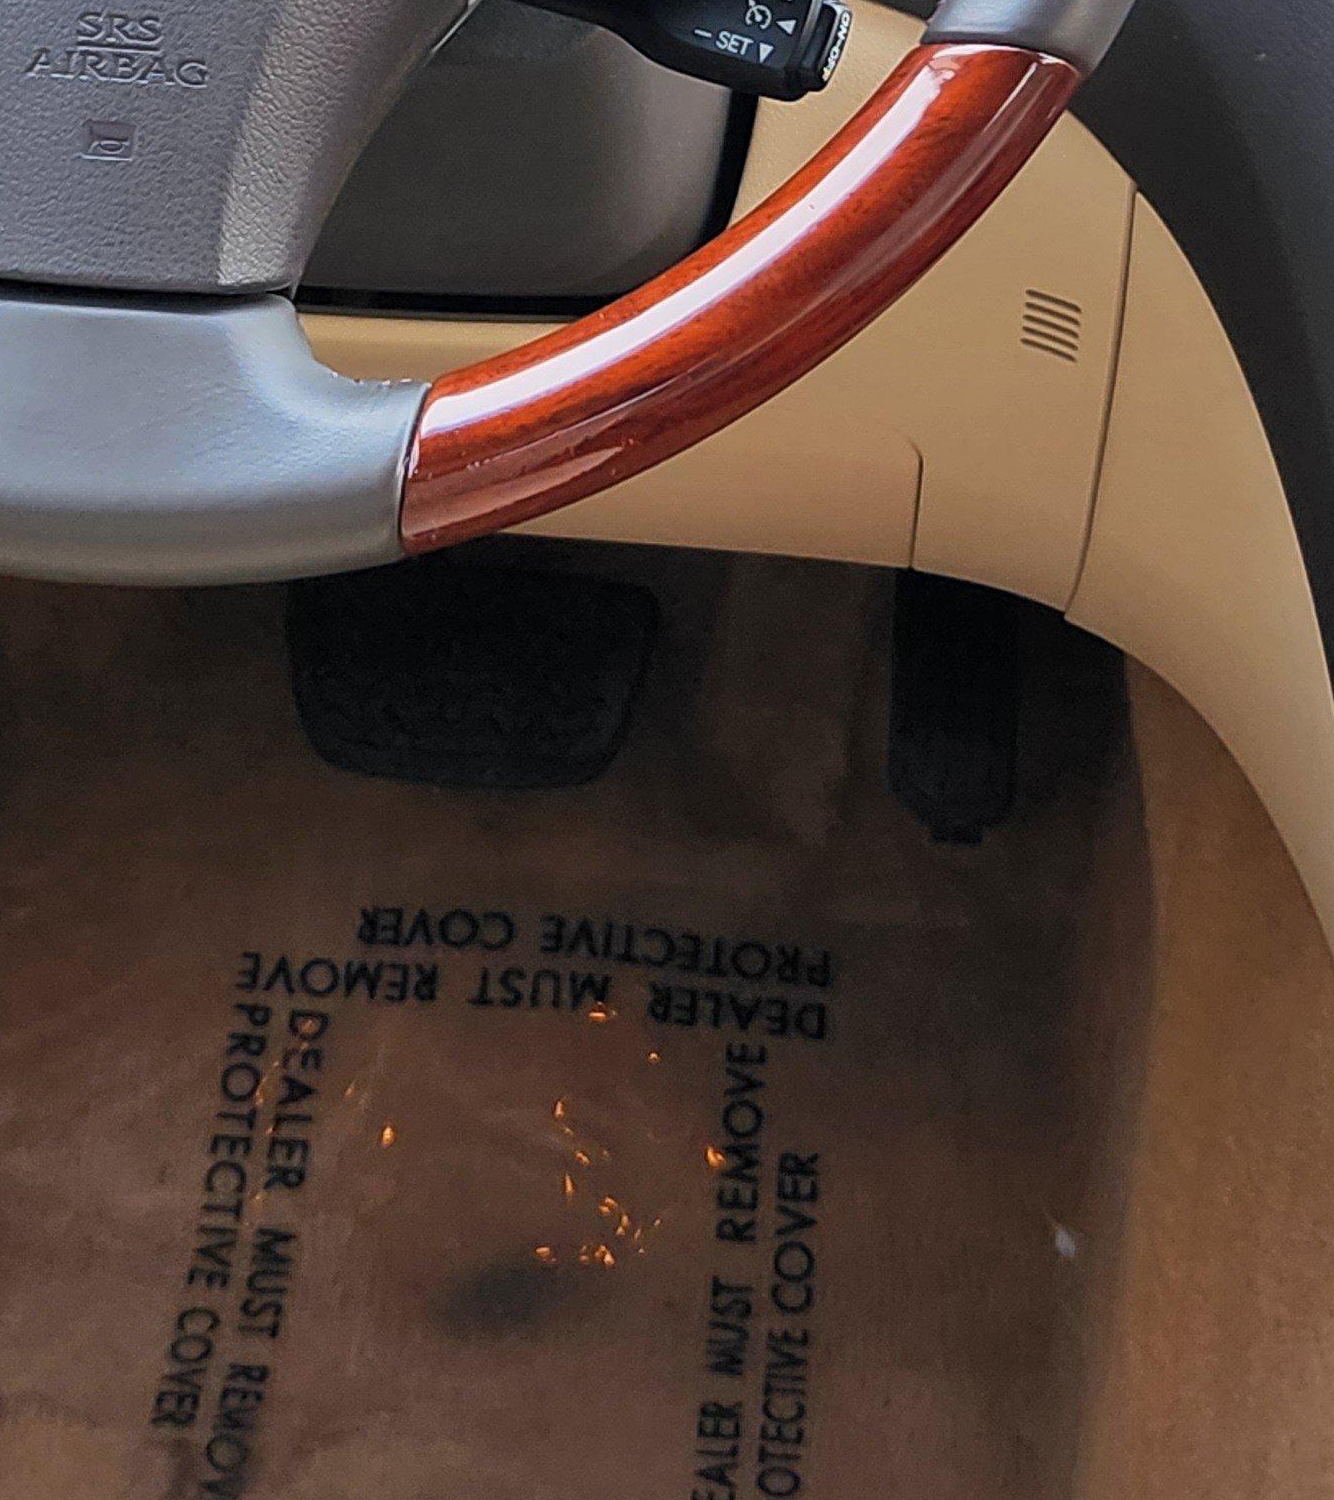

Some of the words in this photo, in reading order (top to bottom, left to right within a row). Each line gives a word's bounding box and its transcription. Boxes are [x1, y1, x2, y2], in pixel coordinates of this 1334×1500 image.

[24, 47, 210, 89] AIRBAG
[75, 12, 164, 46] SRS
[715, 30, 754, 56] SET
[234, 950, 439, 1003] REMOVE
[356, 905, 515, 953] COVER
[540, 913, 833, 989] PROTECTIVE
[470, 966, 612, 1011] MUST
[647, 982, 827, 1041] DEALER
[187, 1002, 272, 1289] PROTECTIVE
[263, 1009, 329, 1189] DEALER
[716, 1042, 766, 1243] REMOVE
[237, 1227, 299, 1339] MUST
[770, 1152, 821, 1315] COVER
[150, 1306, 221, 1428] COVER
[706, 1275, 754, 1377] MUST
[198, 1363, 271, 1500] REMOV
[756, 1329, 809, 1498] OTECTIVE
